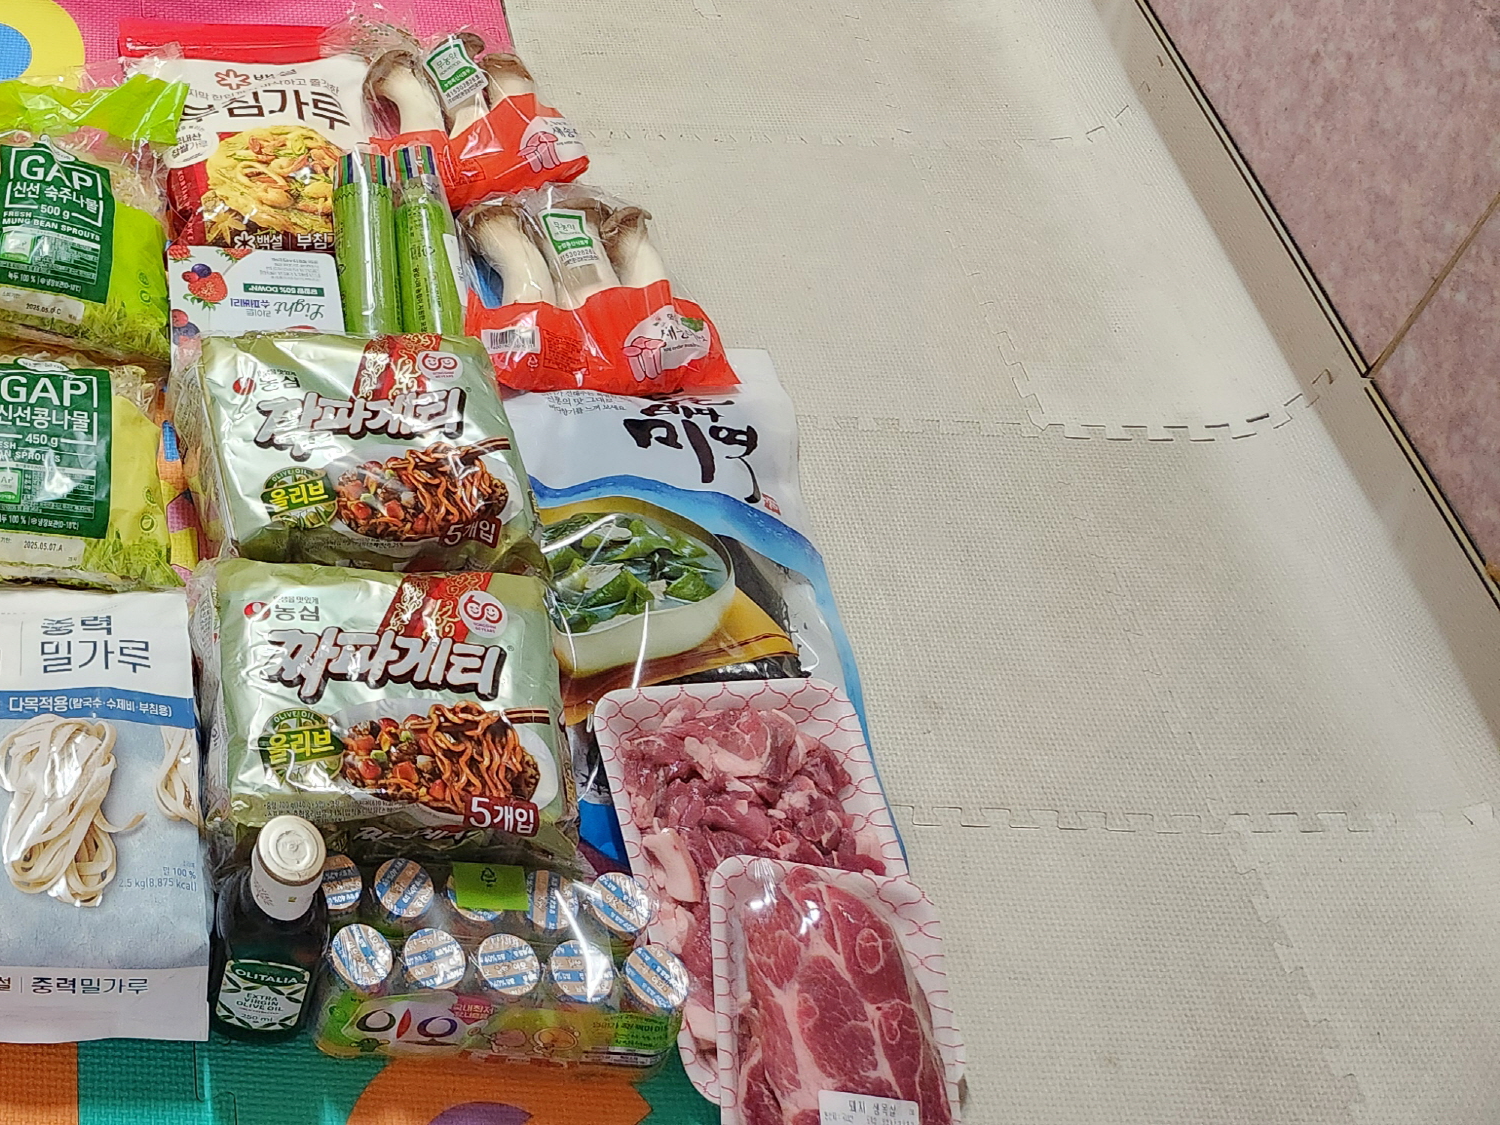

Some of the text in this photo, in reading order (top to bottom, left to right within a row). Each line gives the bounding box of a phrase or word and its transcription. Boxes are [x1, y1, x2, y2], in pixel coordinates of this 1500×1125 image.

[436, 52, 457, 69] 무농약
[20, 155, 93, 191] GAP
[13, 182, 99, 213] 신선 숙주나물
[40, 204, 70, 220] 500 g
[33, 220, 58, 229] BEAN
[60, 225, 100, 242] SPROUTS
[257, 234, 282, 250] 백설
[230, 297, 270, 310] 슈퍼베리
[273, 301, 325, 321] Light
[246, 309, 271, 318] 라이트
[0, 375, 88, 407] GAP
[25, 434, 58, 447] 450 g
[623, 419, 762, 504] 미역
[269, 480, 330, 512] 올리브
[444, 520, 496, 546] 5개입
[273, 604, 321, 623] 농심
[41, 615, 113, 637] 중력
[40, 638, 151, 674] 밀가루
[265, 626, 508, 705] 짜파게티
[273, 711, 316, 725] OLIVE OIL
[268, 729, 336, 764] 올리브
[469, 796, 536, 832] 5개입
[172, 867, 187, 878] 100
[118, 878, 132, 889] 2.5
[234, 968, 298, 984] OLITALIA
[31, 977, 148, 995] 중력밀가루
[236, 1000, 284, 1012] OLIVE OIL
[244, 997, 279, 1007] VIRGIN
[246, 992, 278, 1002] EXTRA
[240, 1013, 273, 1023] 250 ml
